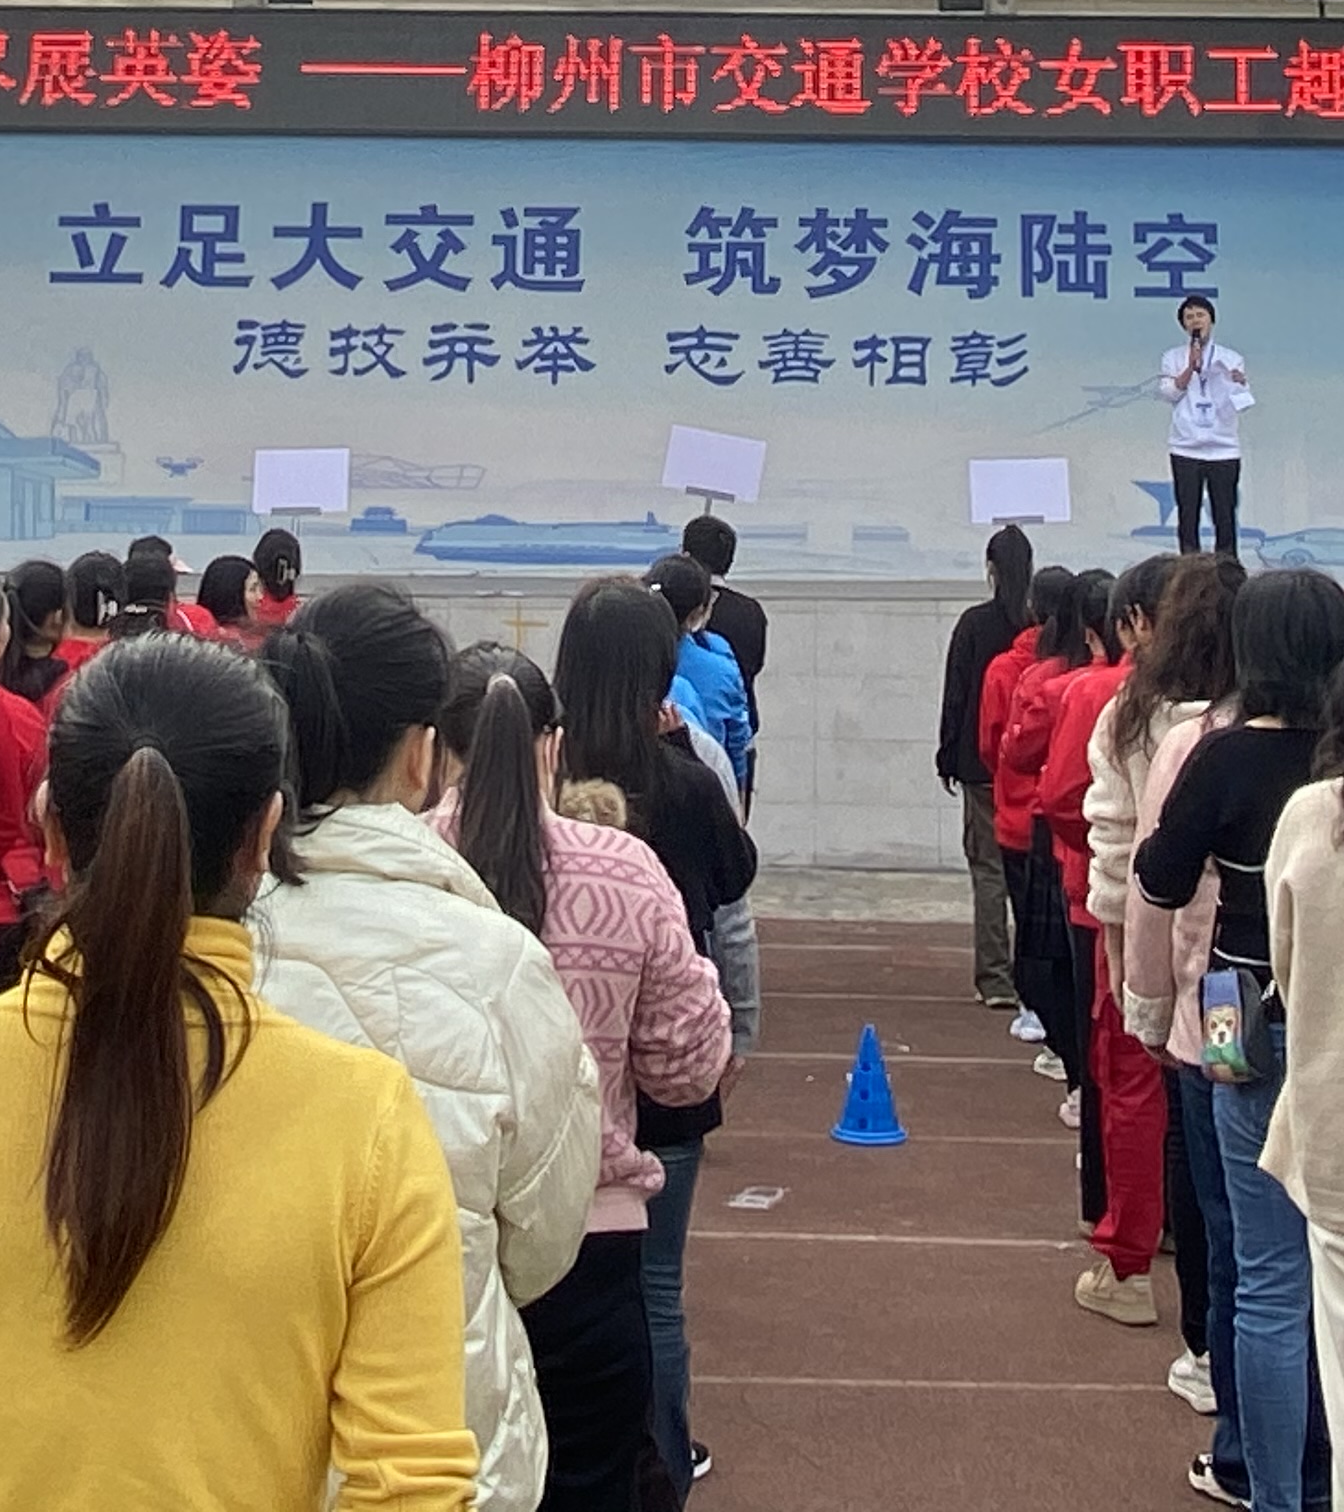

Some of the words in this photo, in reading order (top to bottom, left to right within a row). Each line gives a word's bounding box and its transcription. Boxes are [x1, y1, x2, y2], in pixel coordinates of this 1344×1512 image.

[48, 201, 587, 293] 立足大交通
[683, 204, 1219, 300] 筑梦海陆空
[232, 318, 597, 385] 德技并举
[663, 324, 1030, 388] 志善相彰
